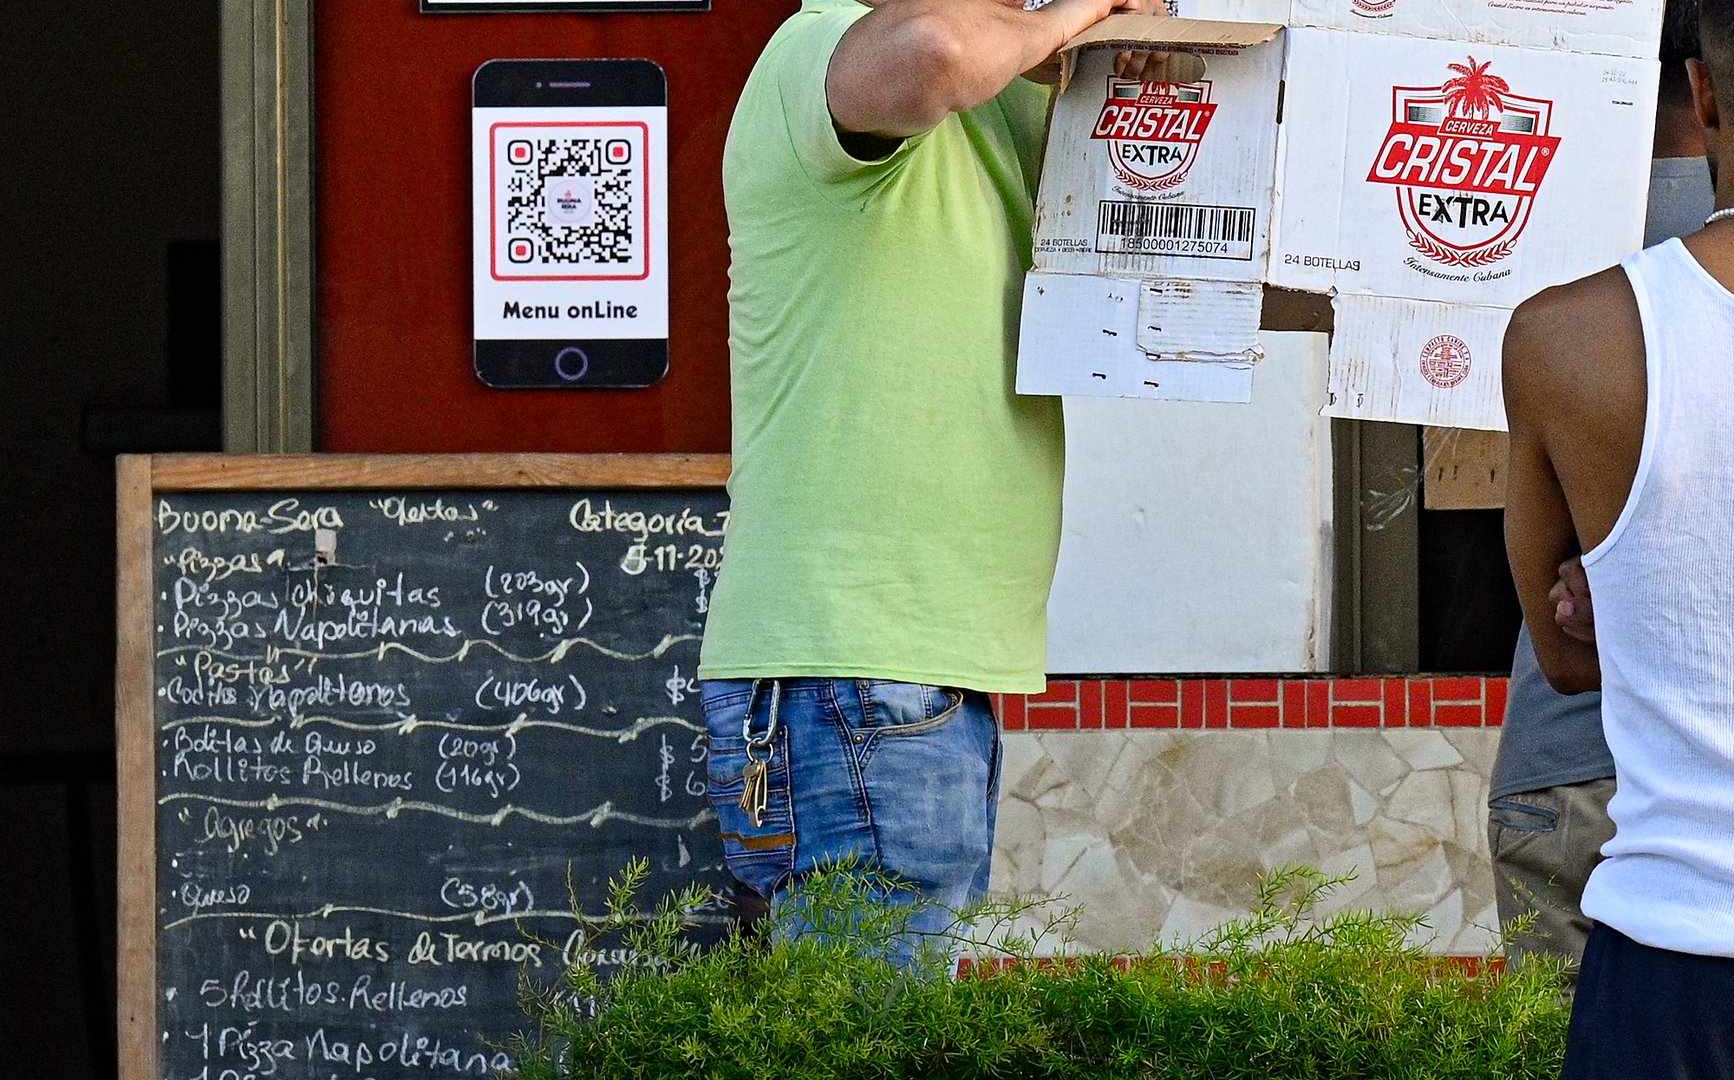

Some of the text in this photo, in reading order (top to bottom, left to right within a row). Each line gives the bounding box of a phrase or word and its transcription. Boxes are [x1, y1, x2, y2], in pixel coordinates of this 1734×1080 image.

[1139, 93, 1173, 106] CERVEZA
[1095, 105, 1202, 142] CRISTAL
[1444, 119, 1495, 136] CERVEZA
[1122, 144, 1183, 166] EXTRA
[1374, 133, 1537, 192] CRISTAL
[1418, 193, 1510, 229] EXTRA
[1040, 238, 1088, 247] 24 BOTELLAS
[1120, 237, 1229, 255] 18500001275074
[1284, 253, 1361, 272] 24 BOTELLAS
[1401, 256, 1513, 283] Intensamente Cubana
[503, 301, 638, 320] Menu onLine
[174, 577, 279, 621] Pizzas
[173, 610, 267, 650] Pizzas
[475, 673, 587, 714] (406gr)
[270, 730, 294, 754] de
[438, 733, 518, 767] (20gr)
[302, 754, 413, 790] Rellenos
[435, 761, 521, 799] (116gr)
[180, 882, 251, 918] Queso
[407, 931, 443, 966] de
[200, 978, 229, 1008] 5
[349, 973, 467, 1012] Rellenos
[184, 1022, 210, 1061] 1
[218, 1020, 298, 1077] Pizza
